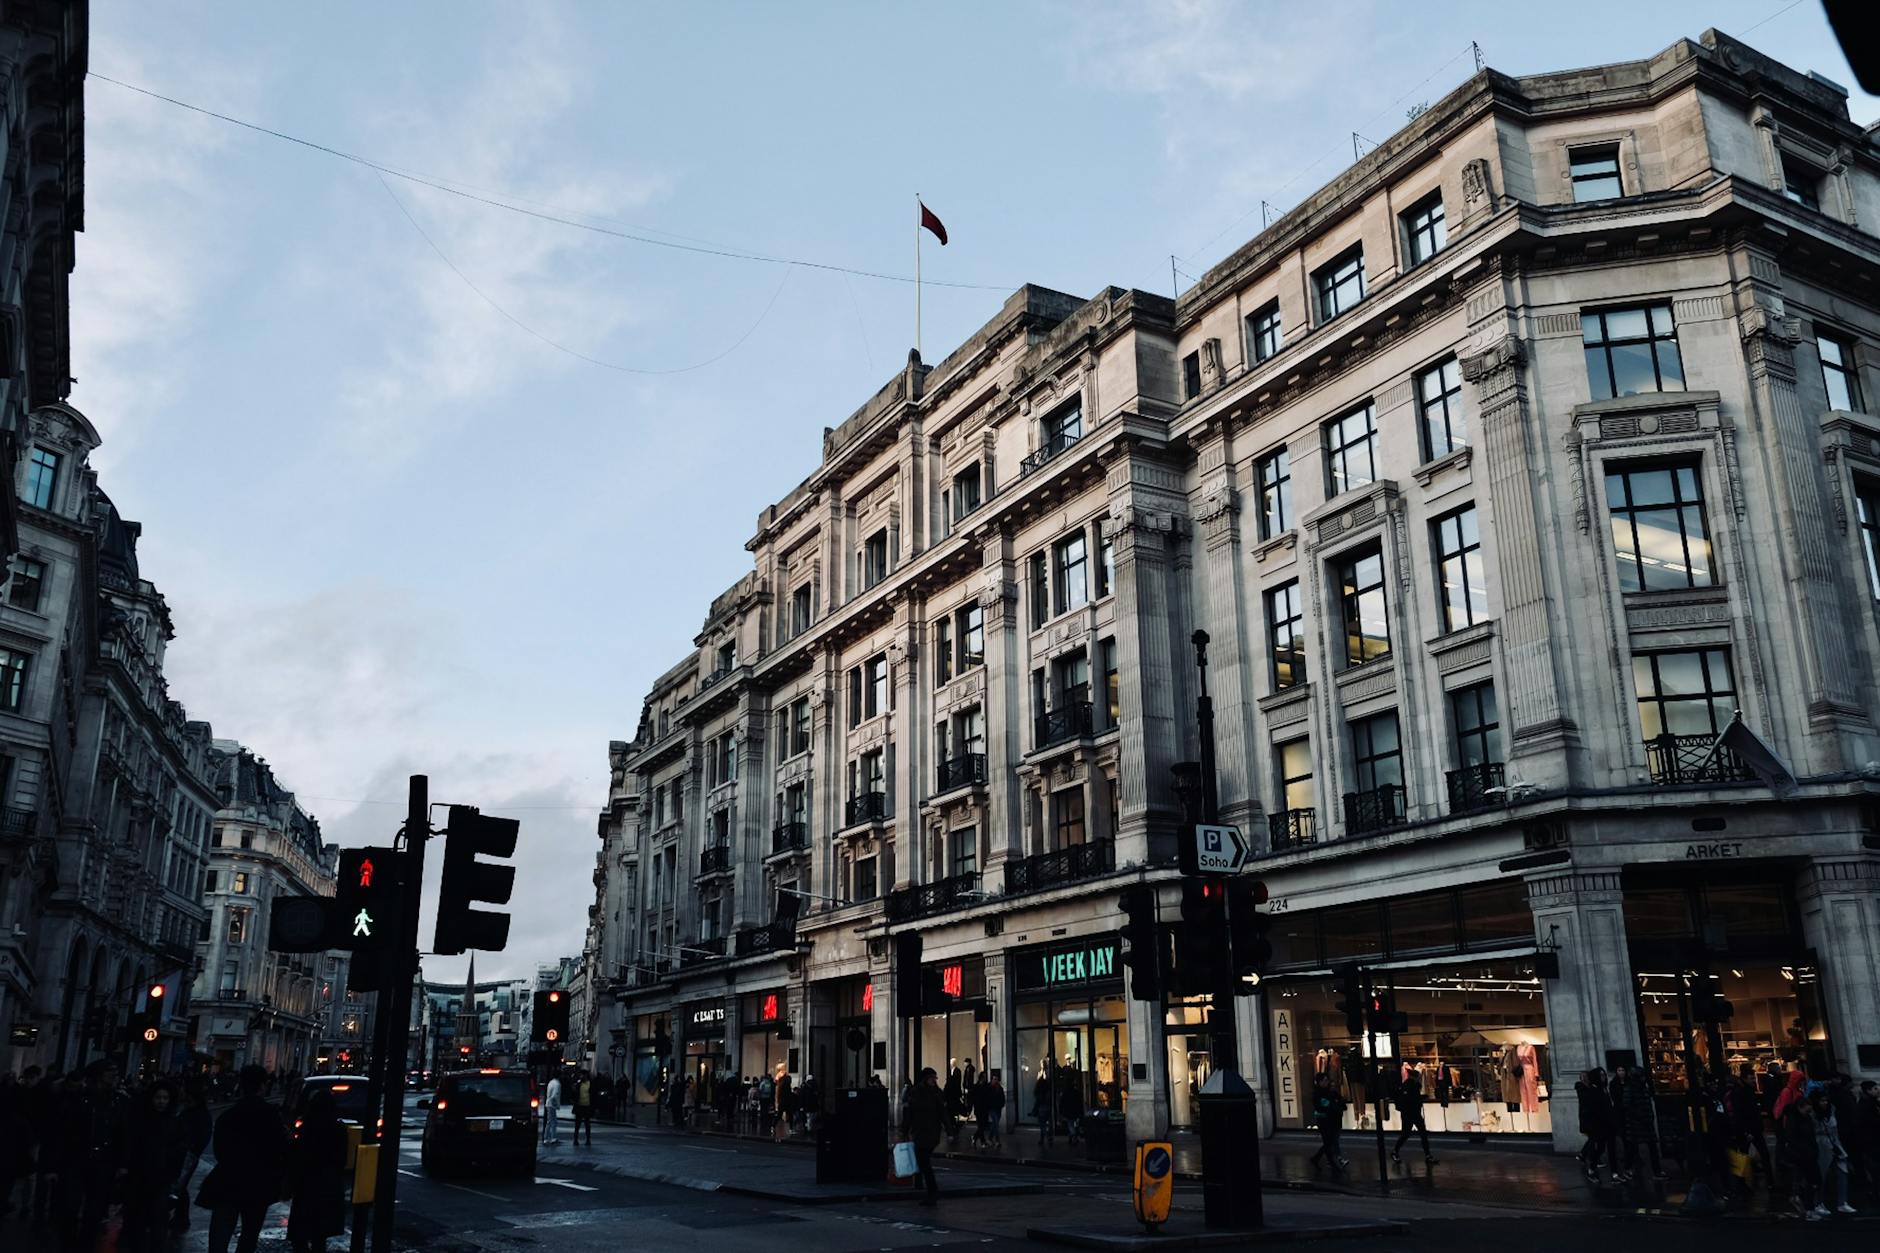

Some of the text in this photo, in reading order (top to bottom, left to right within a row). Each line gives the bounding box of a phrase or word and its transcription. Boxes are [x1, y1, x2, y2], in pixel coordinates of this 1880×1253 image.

[1207, 832, 1219, 849] P
[1686, 843, 1742, 858] ARKET
[1200, 855, 1228, 868] Soho
[1270, 899, 1288, 912] 224
[1278, 1012, 1294, 1115] ARKET
